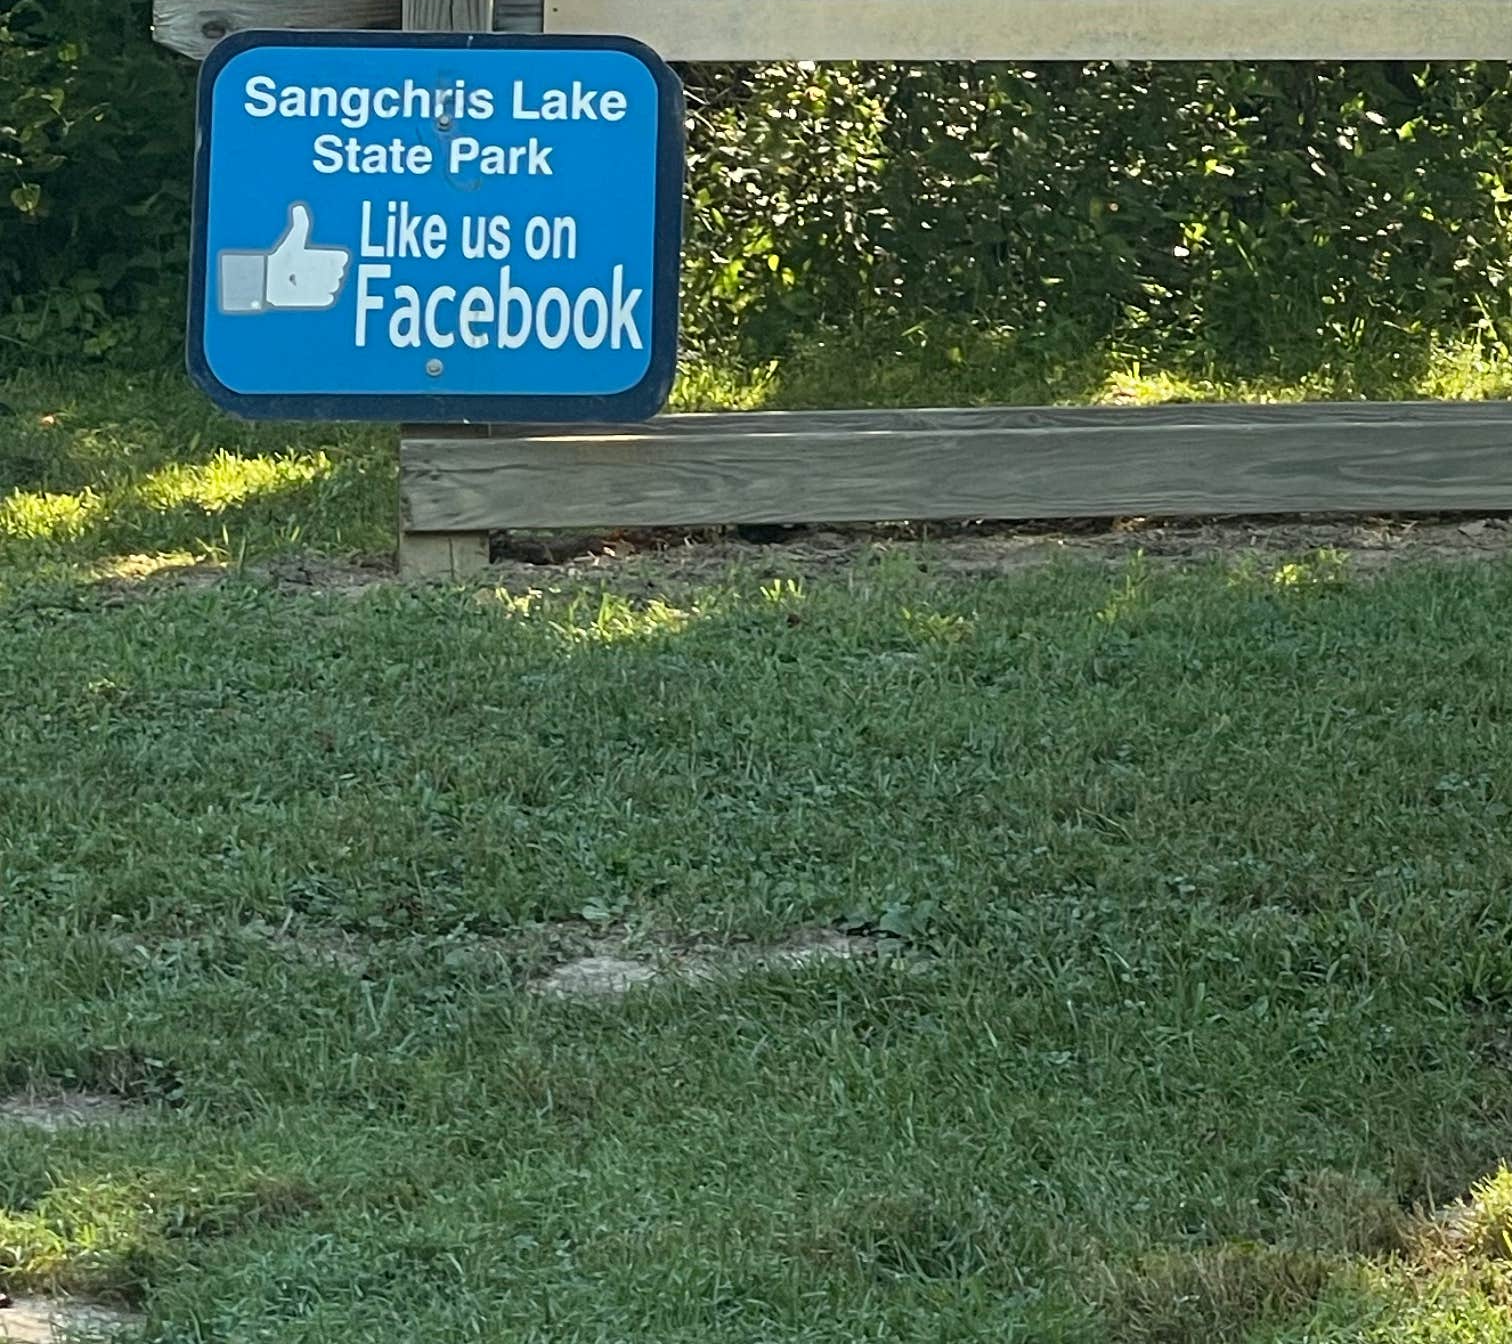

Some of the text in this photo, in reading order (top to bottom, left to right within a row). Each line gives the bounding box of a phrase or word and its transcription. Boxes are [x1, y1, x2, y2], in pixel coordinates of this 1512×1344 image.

[244, 75, 628, 128] Sangchris Lake
[312, 134, 554, 176] State Park
[360, 201, 577, 260] Like us on
[355, 264, 644, 350] Facebook
